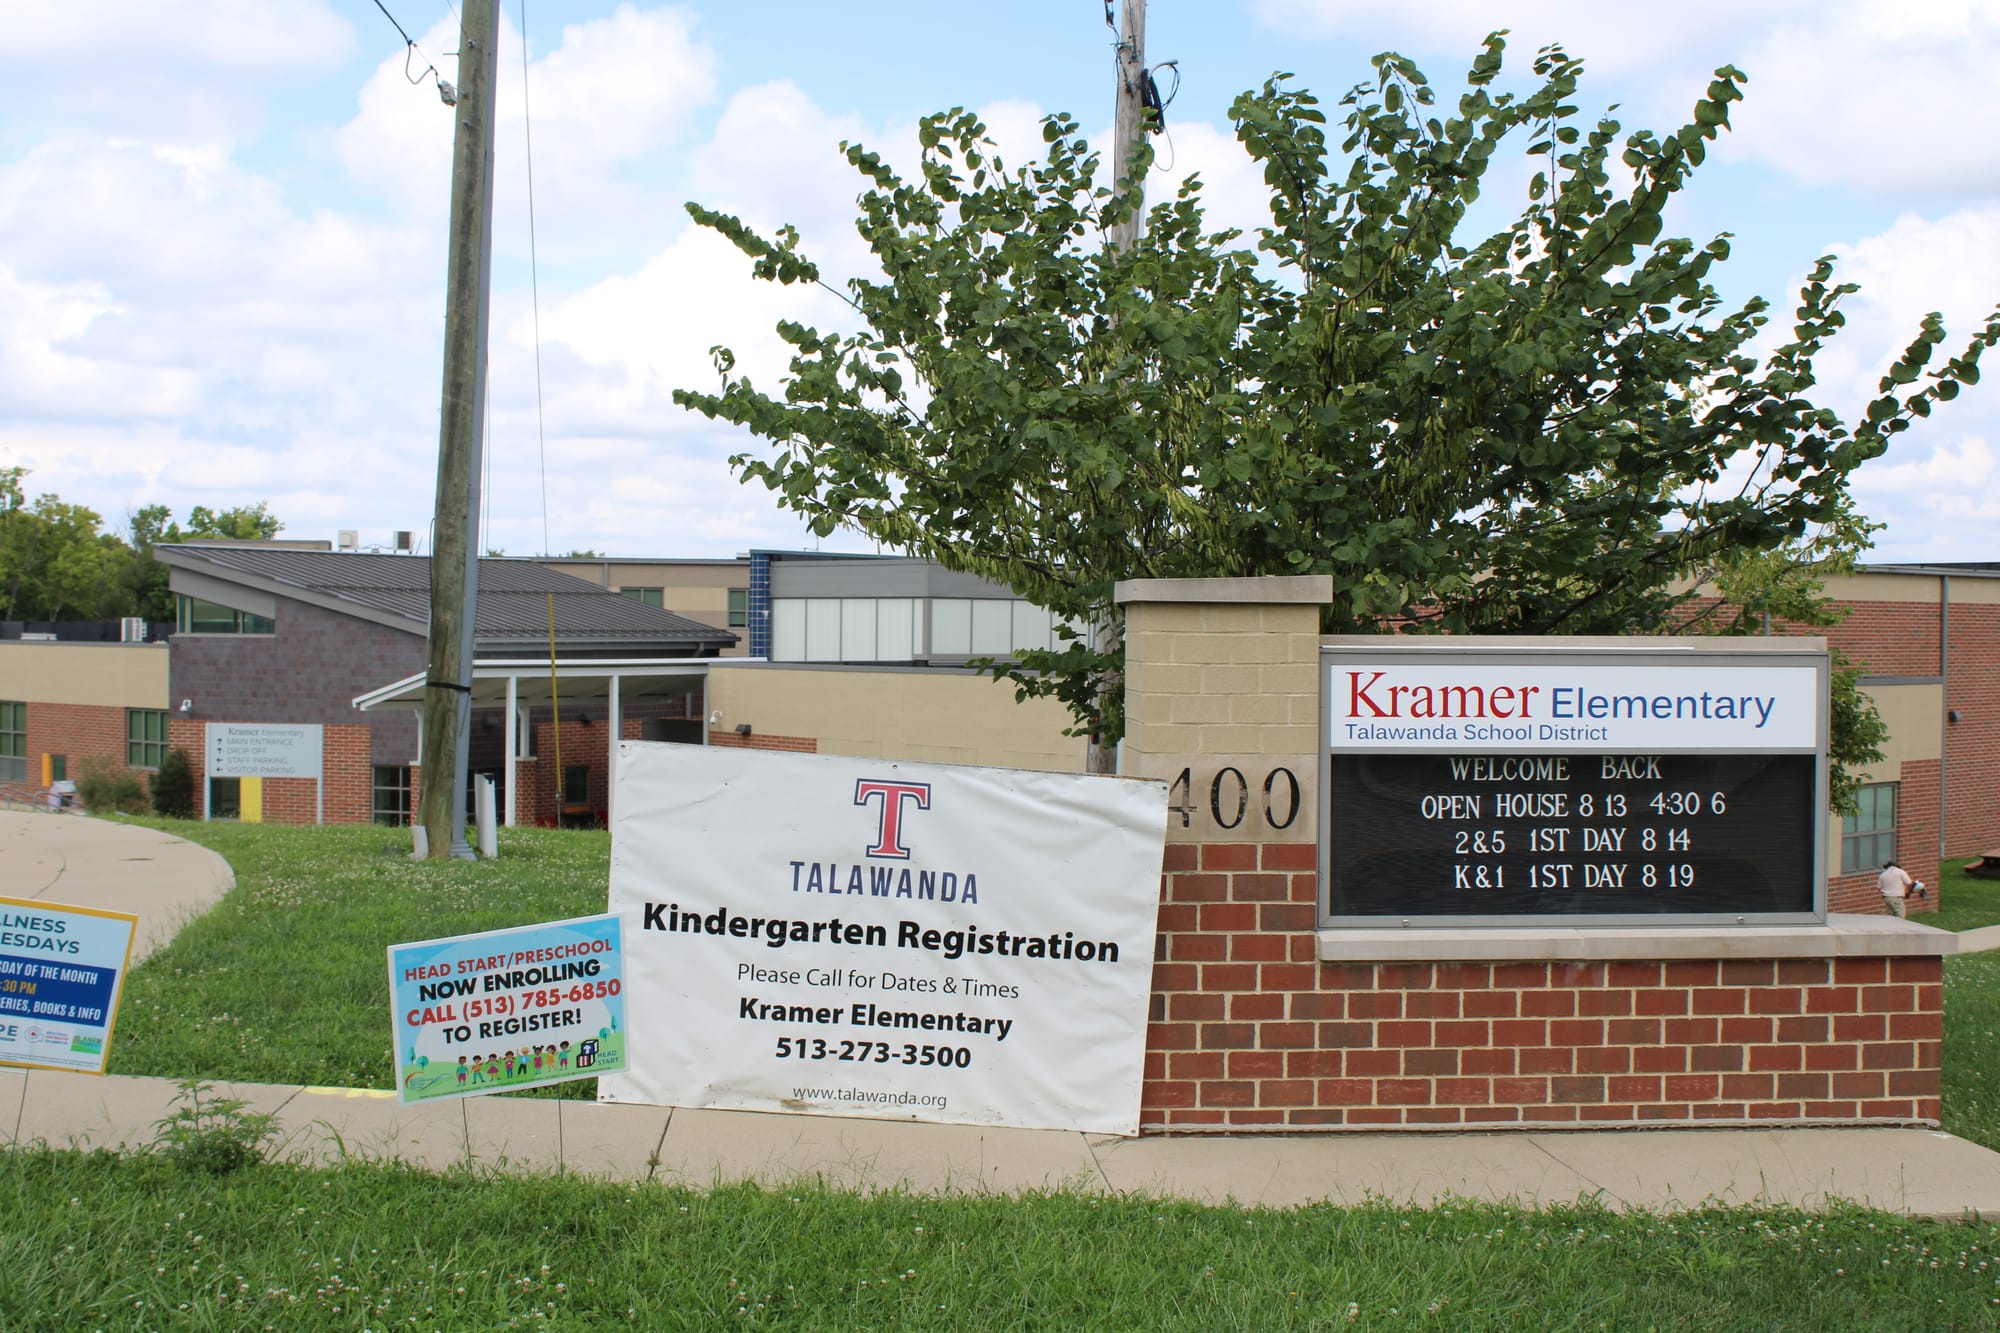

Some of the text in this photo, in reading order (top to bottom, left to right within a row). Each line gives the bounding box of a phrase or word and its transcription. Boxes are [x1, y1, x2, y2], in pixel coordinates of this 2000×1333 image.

[1345, 672, 1775, 728] Kramer Elementary
[227, 738, 294, 746] MAIN ENTRANCE
[228, 727, 304, 738] Kramer Elementary
[1345, 723, 1608, 741] Talawanda School District
[227, 747, 267, 755] DROP OFF
[227, 756, 288, 765] STAFF PARKING
[227, 766, 296, 775] VISITOR PARKING
[1451, 756, 1662, 781] WELCOME BACK
[1168, 767, 1300, 829] 400
[1421, 791, 1726, 819] OPEN HOUSE 8 13 4:30 6
[854, 778, 931, 860] T
[1455, 828, 1690, 854] 2&5 1ST DAY 8 14
[790, 861, 977, 904] TALAWANDA
[1455, 864, 1694, 888] K&1 1ST DAY 8 19
[0, 914, 66, 933] LNESS
[643, 902, 1119, 963] Kindergarten Registration
[405, 939, 612, 981] HEAD START/PRESCHOOL
[24, 963, 39, 977] OF
[40, 965, 59, 980] THE
[60, 968, 98, 985] MONTH
[420, 959, 600, 1001] NOW ENROLLING
[737, 963, 1019, 999] Please Call for Dates & Times
[19, 981, 37, 995] PM
[33, 1000, 66, 1017] BOOKS
[67, 1005, 76, 1017] &
[77, 1006, 101, 1021] INFO
[407, 978, 621, 1026] CALL (513) 785-6850
[443, 1008, 582, 1044] TO REGISTER!
[739, 997, 1013, 1041] Kramer Elementary
[597, 1050, 616, 1058] HEAD
[597, 1057, 618, 1066] START
[776, 1037, 971, 1069] 513-273-3500
[793, 1087, 947, 1110] www.talawanda.org
